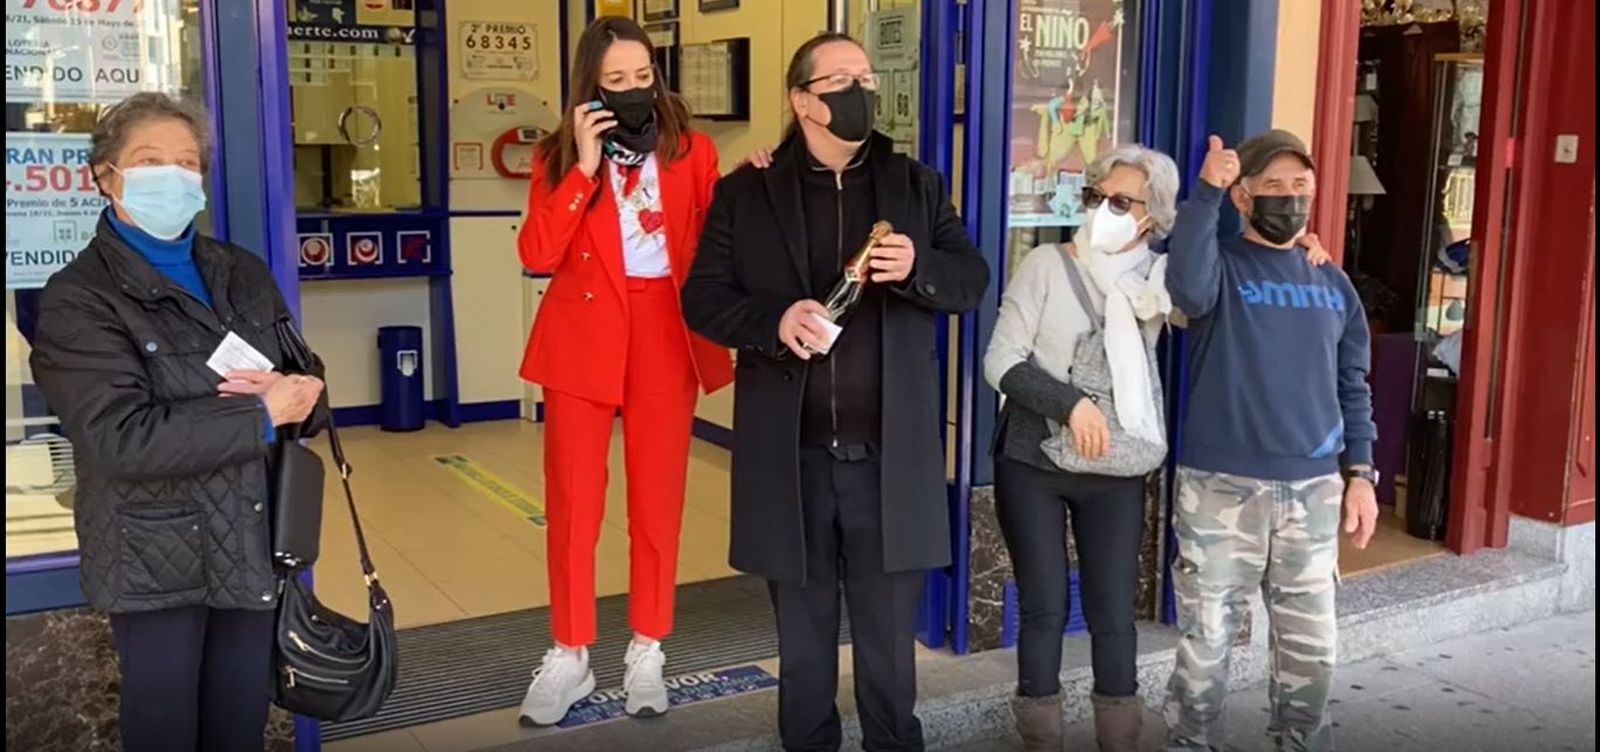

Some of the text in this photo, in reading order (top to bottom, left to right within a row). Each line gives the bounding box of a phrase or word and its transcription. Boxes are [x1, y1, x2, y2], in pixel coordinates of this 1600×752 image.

[1020, 9, 1089, 50] EL NIÑO
[466, 34, 531, 50] 68345
[6, 249, 76, 266] ENDID
